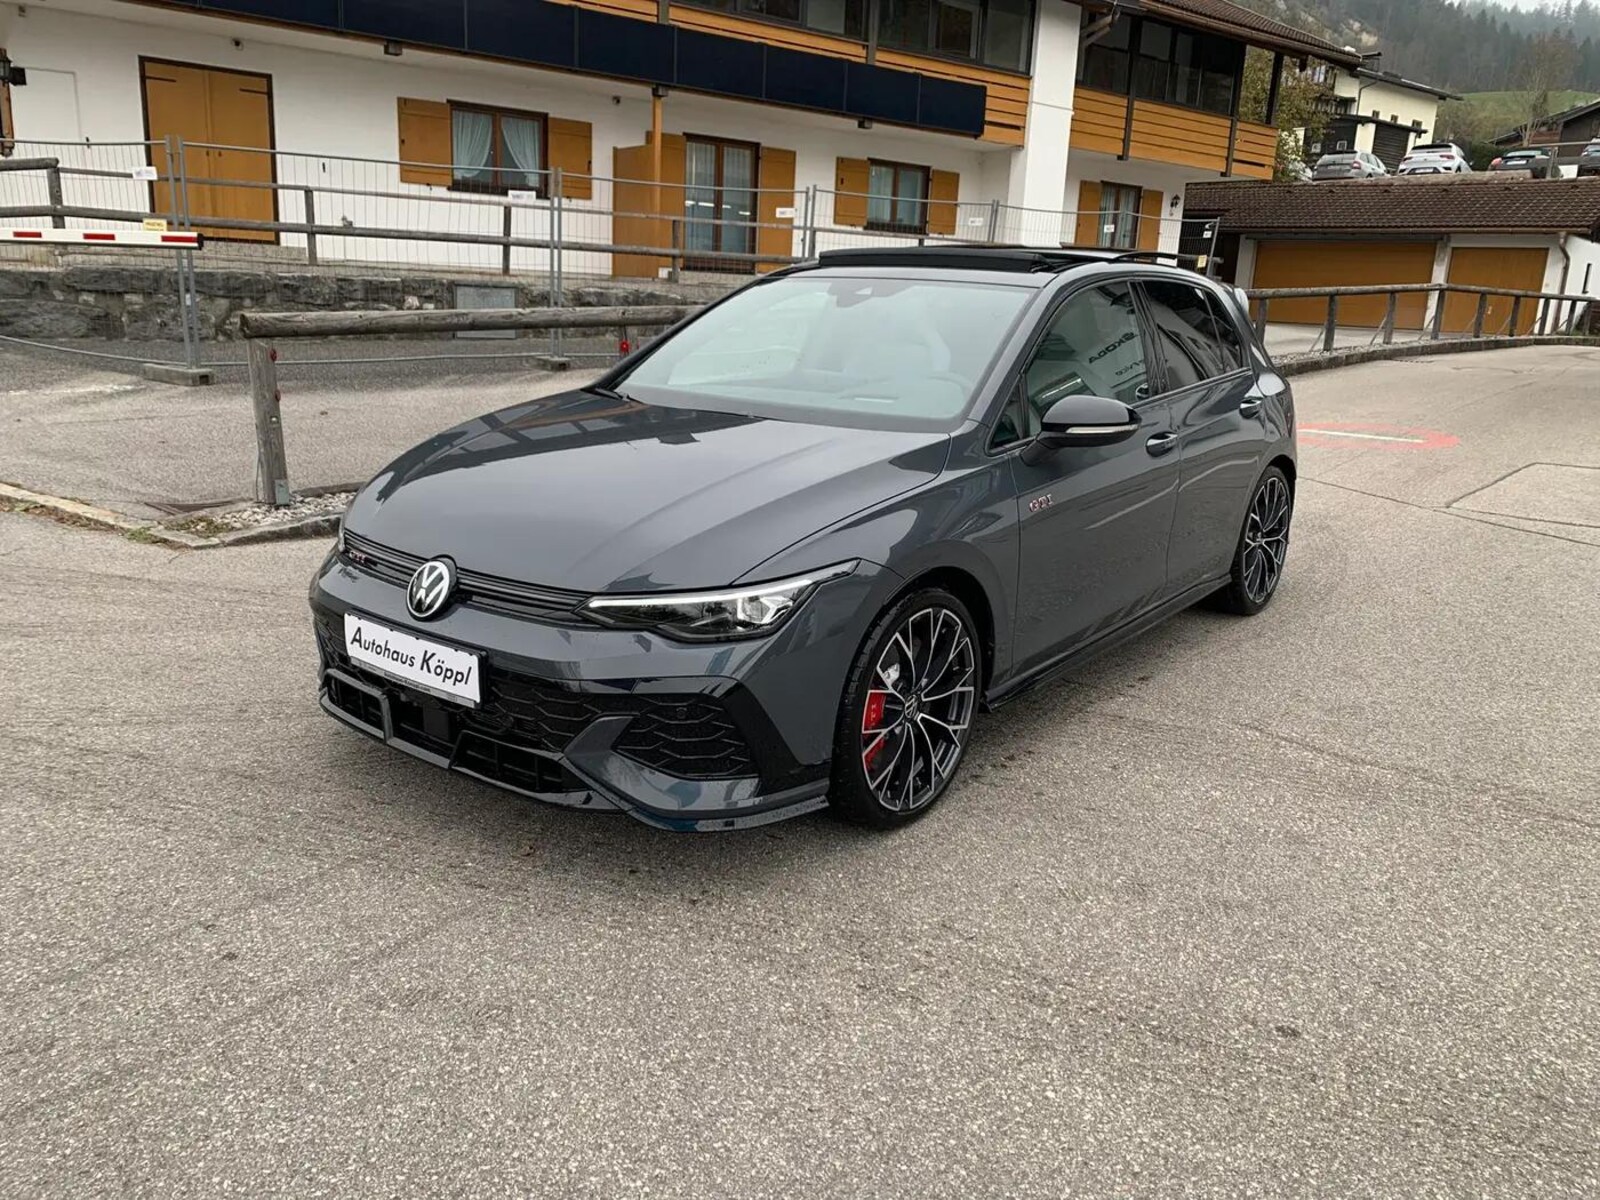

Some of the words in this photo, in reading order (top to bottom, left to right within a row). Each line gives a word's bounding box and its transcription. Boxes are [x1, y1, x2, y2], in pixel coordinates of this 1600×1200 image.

[1029, 493, 1054, 513] GTI
[350, 626, 416, 668] Autohaus
[420, 650, 473, 686] Köppl
